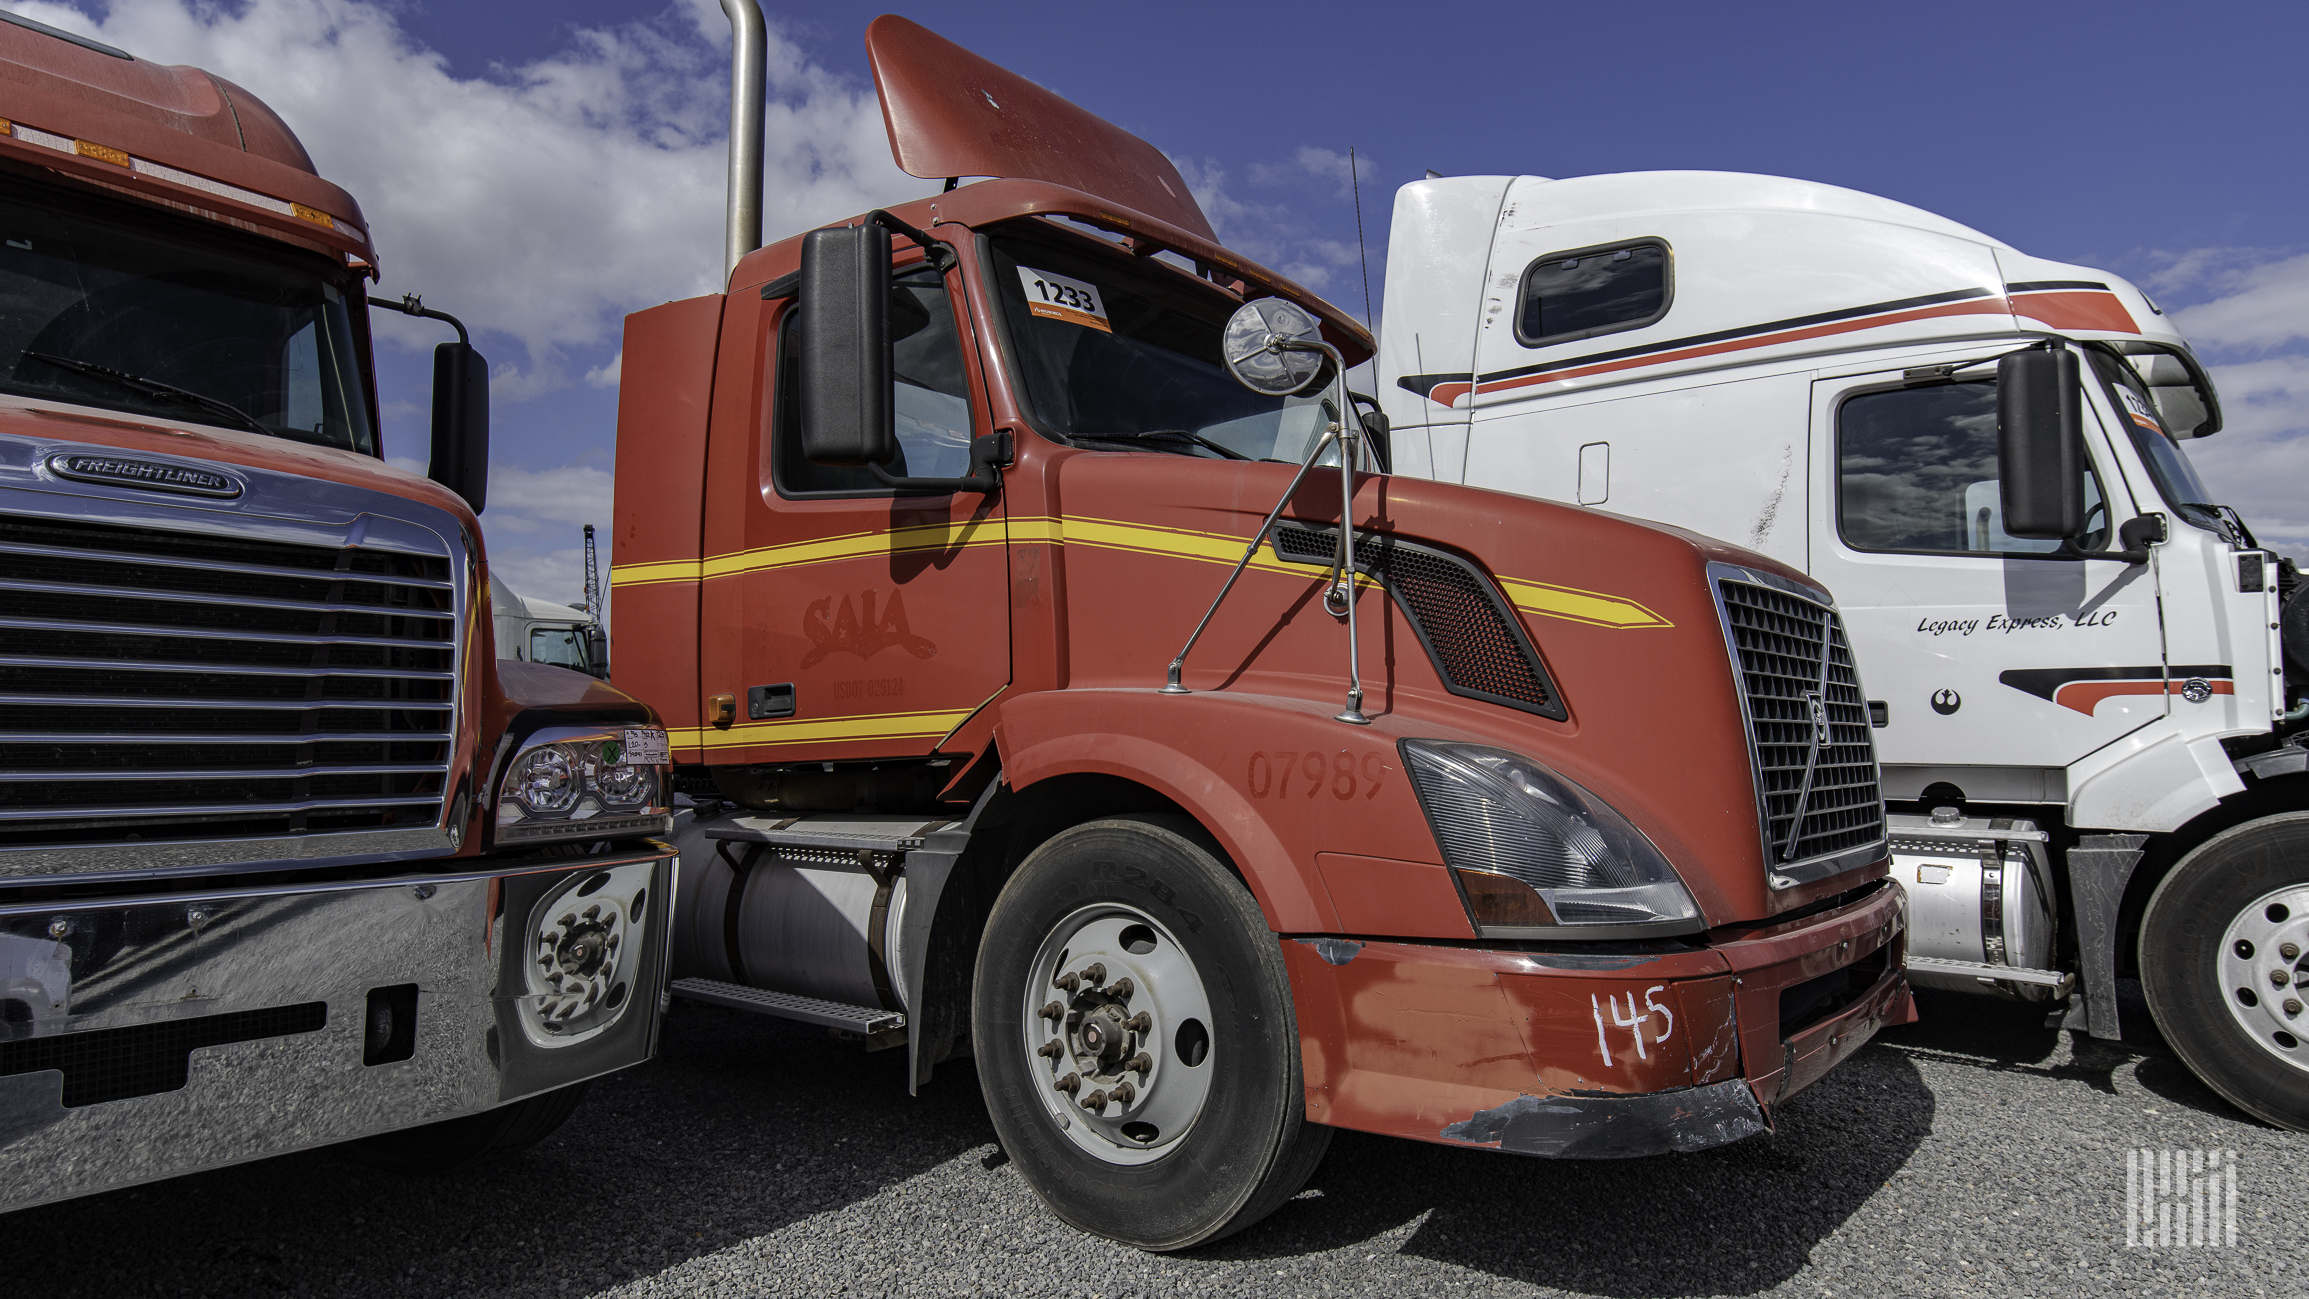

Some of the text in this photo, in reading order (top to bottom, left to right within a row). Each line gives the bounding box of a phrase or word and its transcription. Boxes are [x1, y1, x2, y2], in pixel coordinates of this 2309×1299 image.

[1033, 279, 1096, 313] 1233
[74, 458, 222, 487] FREIGHTLINER
[801, 587, 937, 669] SAIA
[1917, 610, 2118, 637] Legacy Express, LLC
[833, 680, 864, 700] USDOT
[1247, 750, 1387, 801] 07989
[1091, 860, 1207, 937] R284
[1590, 985, 1673, 1067] 145
[1000, 1085, 1157, 1212] BRIDGESTONE
